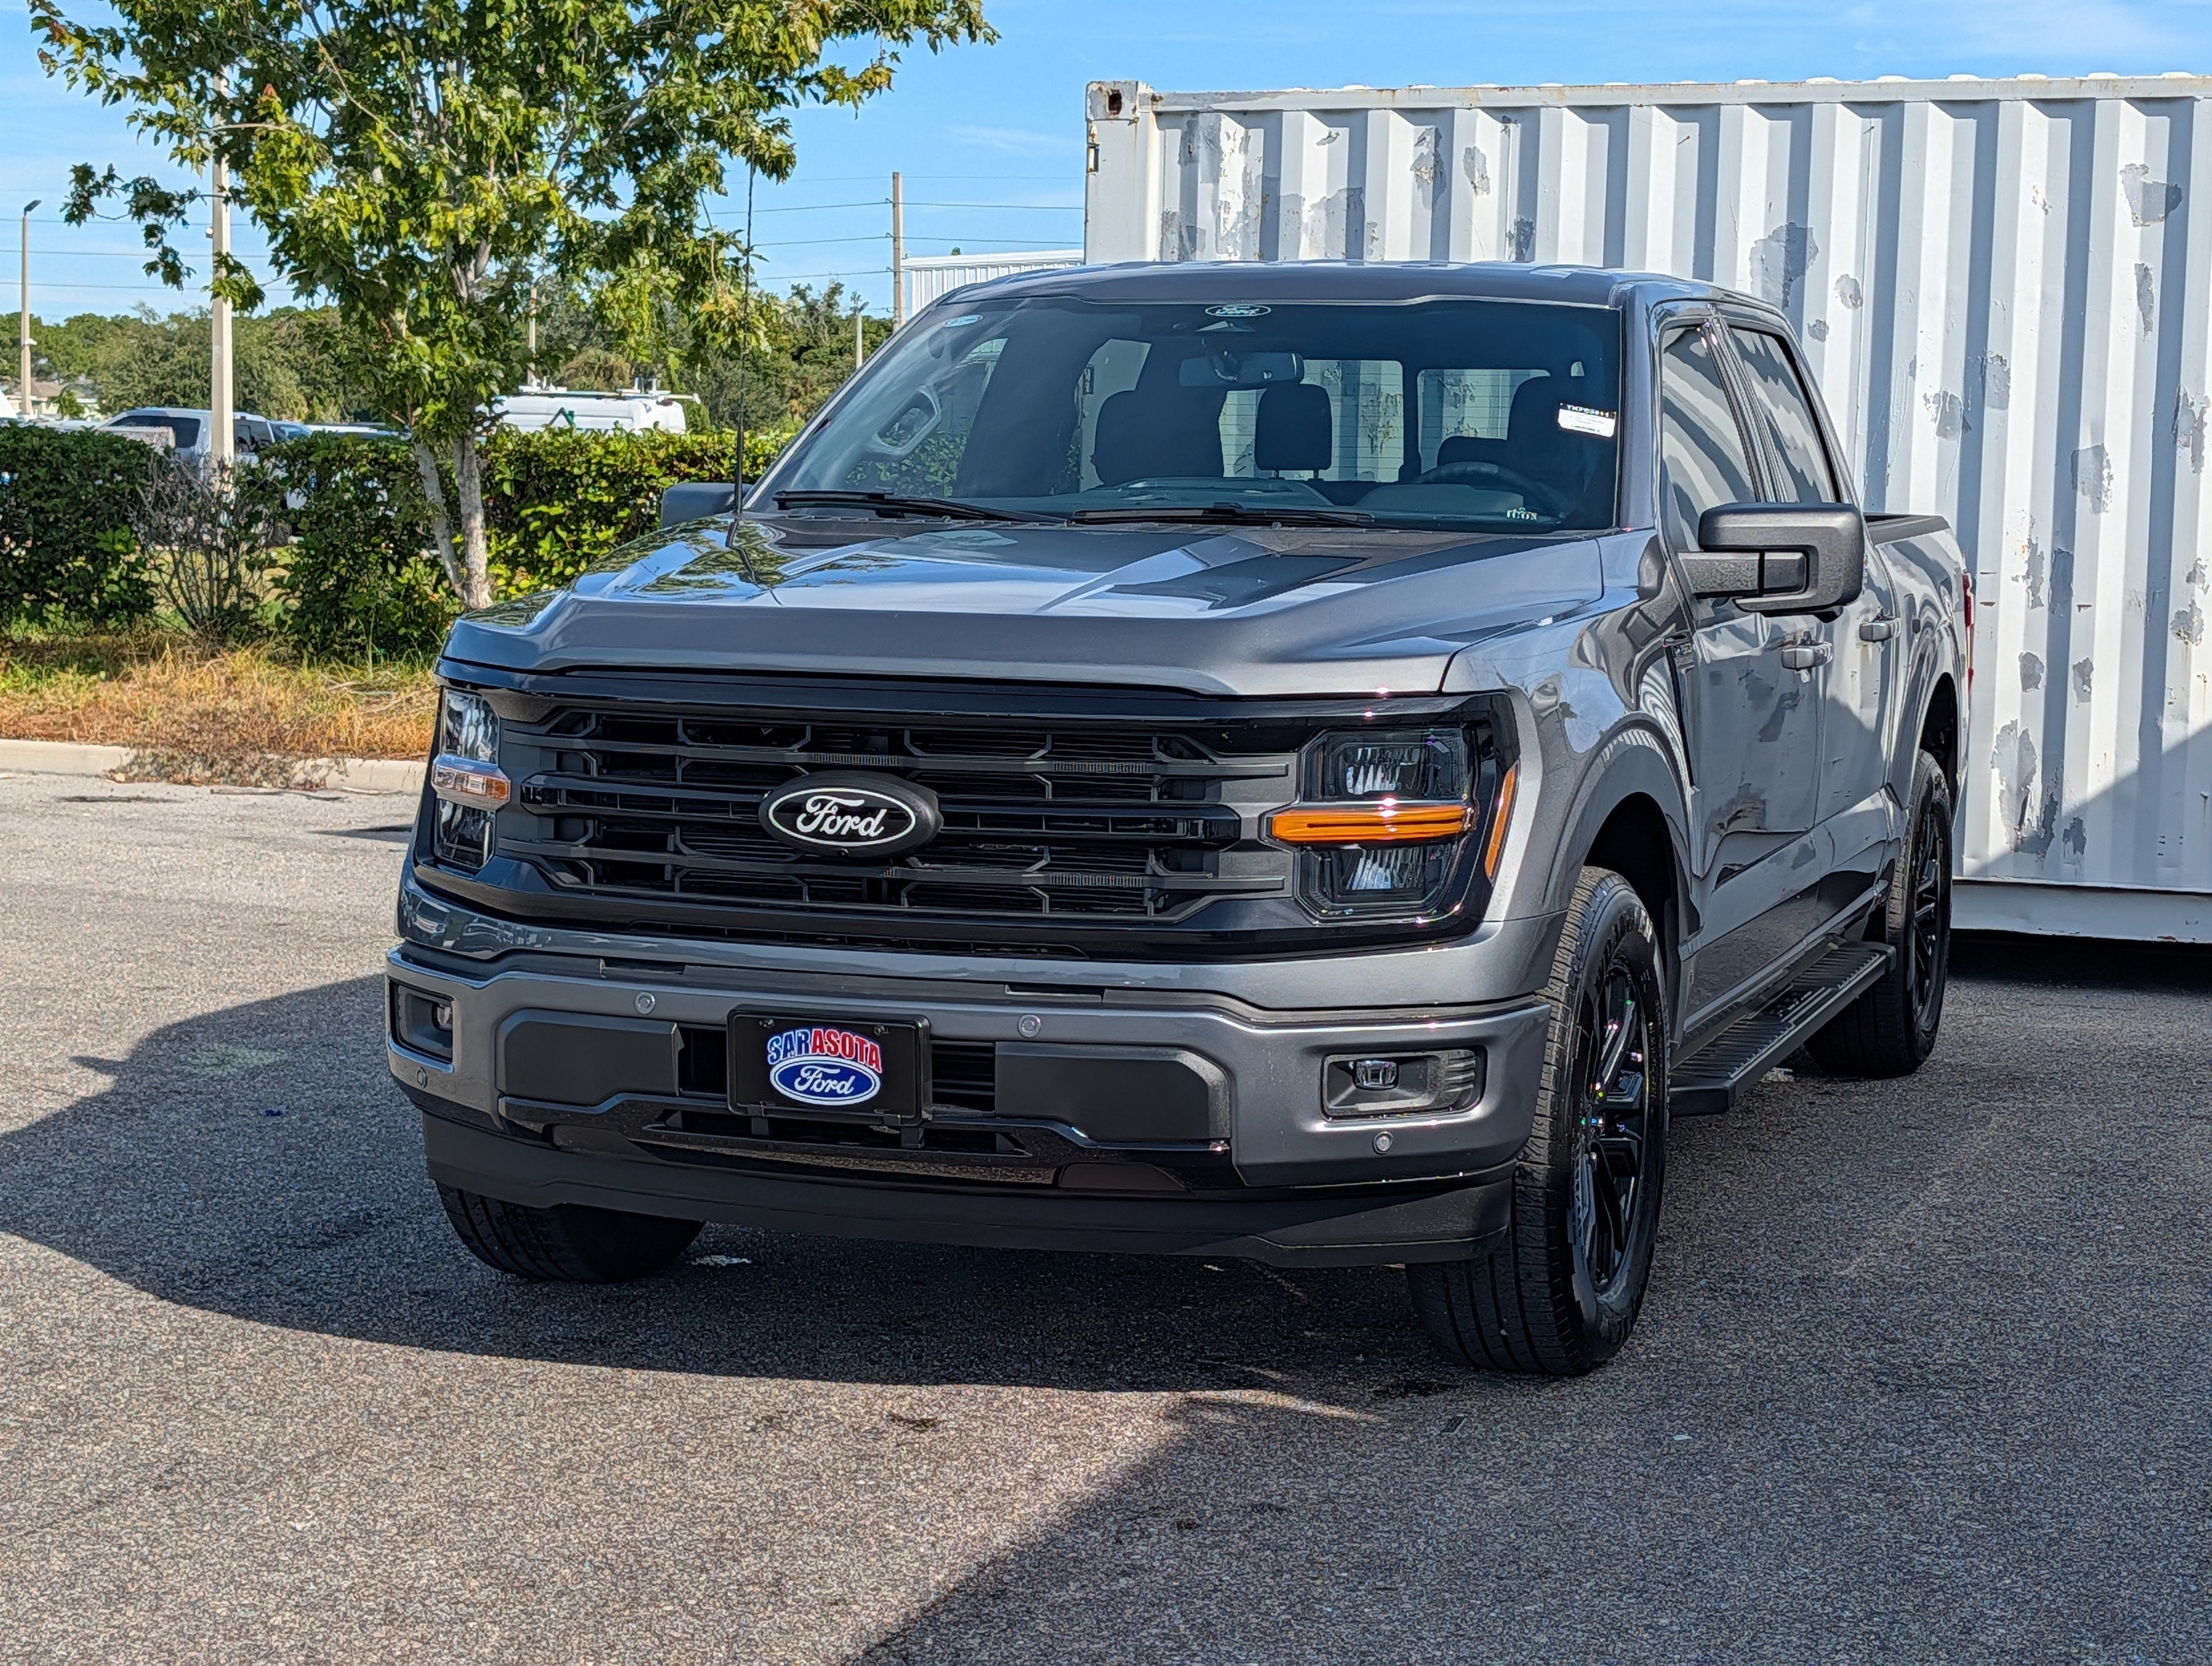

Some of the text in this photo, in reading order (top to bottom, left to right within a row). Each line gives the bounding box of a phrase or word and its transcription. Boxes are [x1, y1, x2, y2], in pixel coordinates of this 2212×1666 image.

[796, 795, 888, 837] Ford
[767, 1028, 883, 1074] SARASOTA
[794, 1065, 856, 1095] Ford
